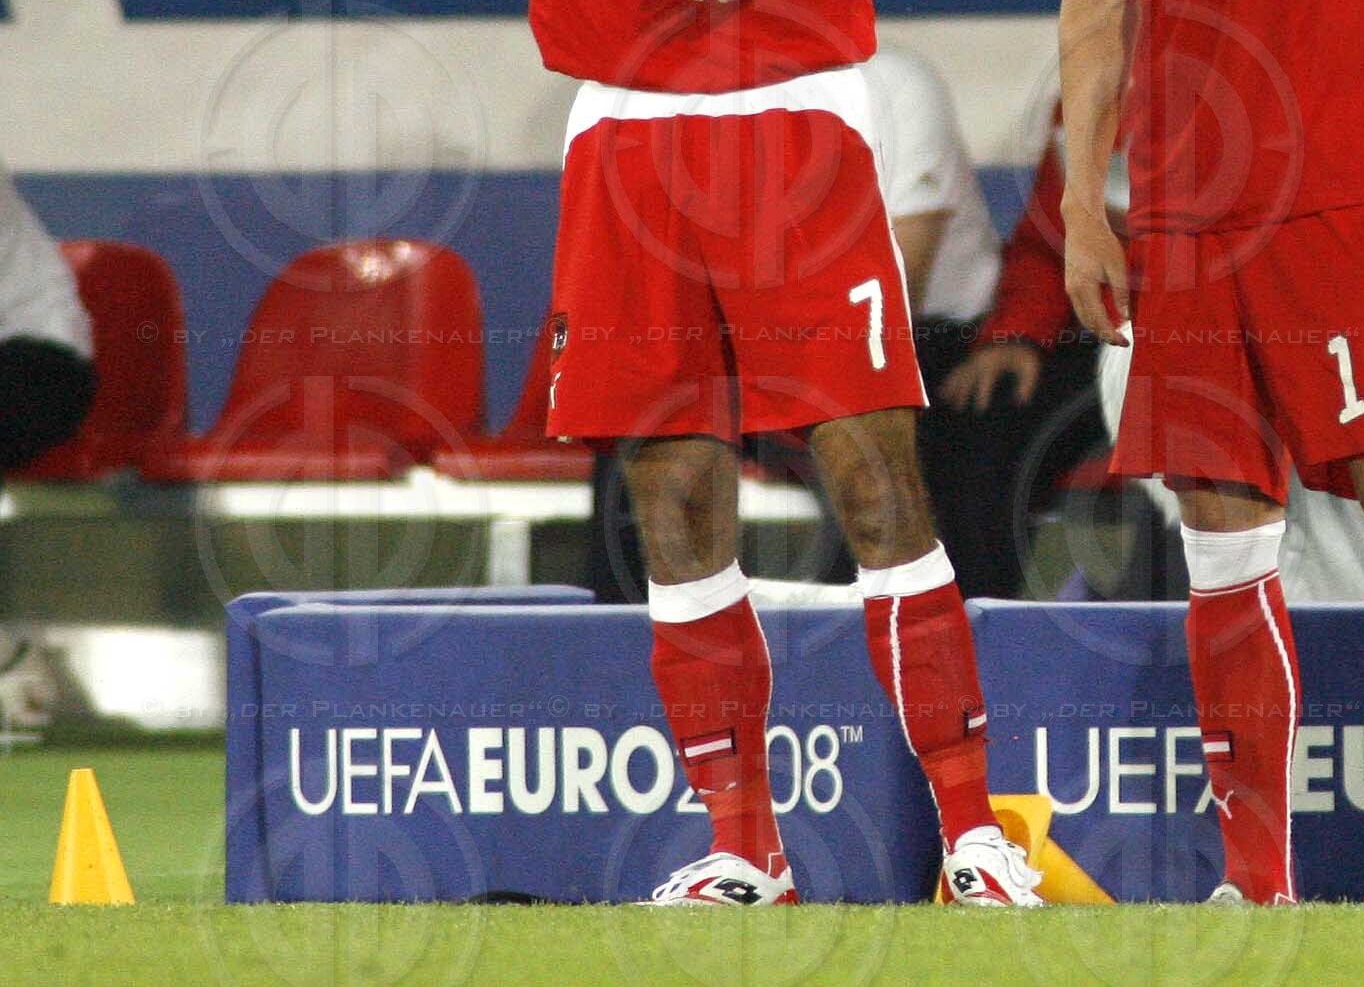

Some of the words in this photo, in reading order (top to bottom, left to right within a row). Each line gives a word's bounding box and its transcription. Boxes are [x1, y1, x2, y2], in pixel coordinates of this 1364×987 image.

[849, 278, 887, 370] 7
[290, 727, 464, 815] UEFA
[467, 725, 844, 815] EURO08
